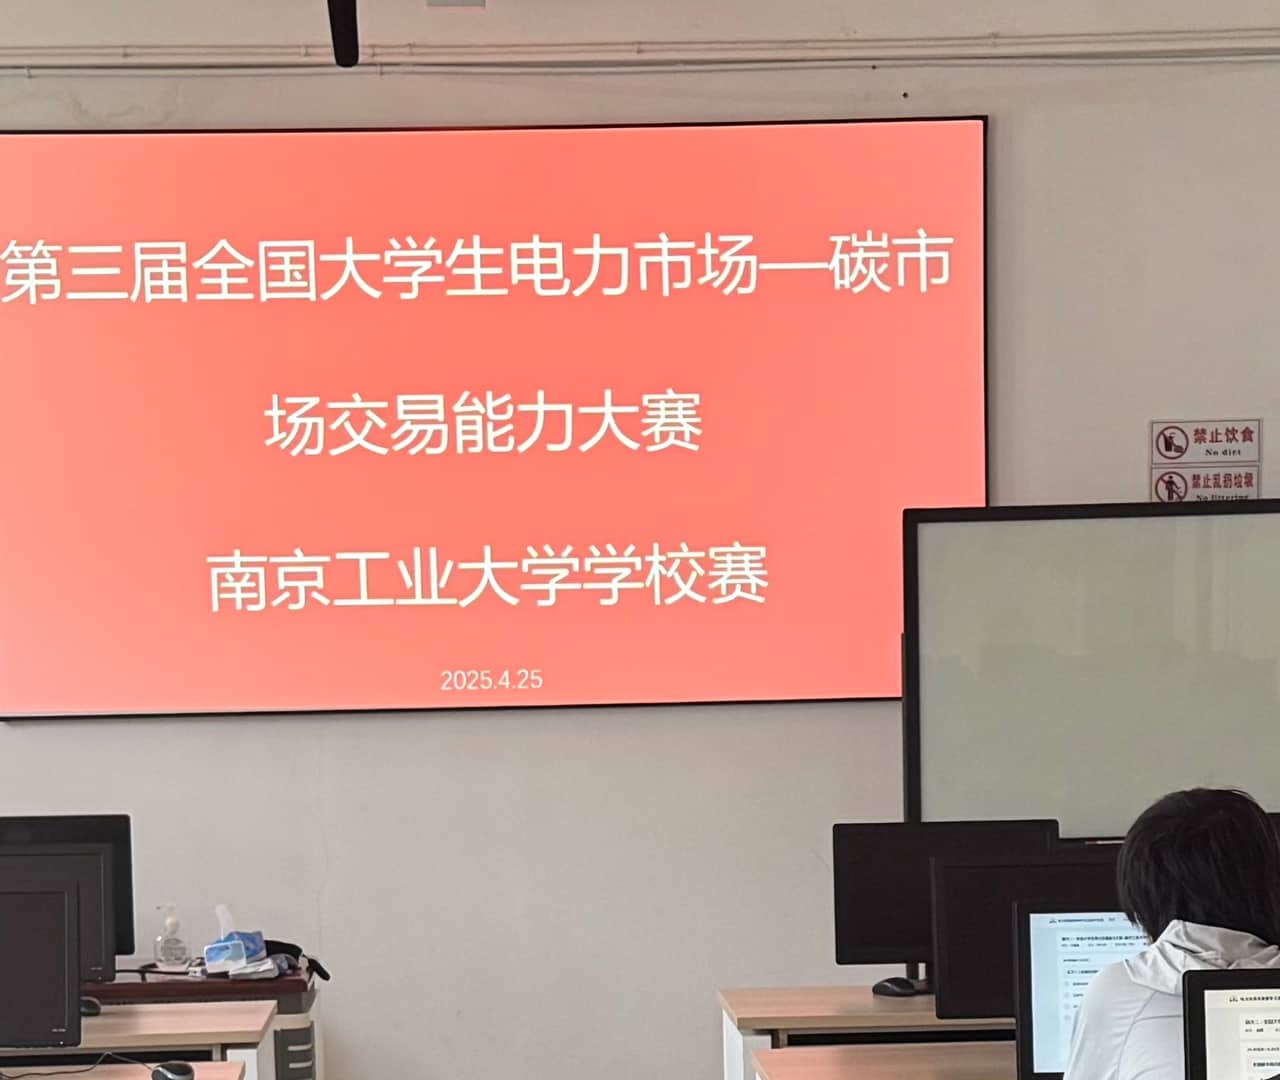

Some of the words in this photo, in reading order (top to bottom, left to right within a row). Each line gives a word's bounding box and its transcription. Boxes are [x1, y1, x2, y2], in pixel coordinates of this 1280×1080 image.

[264, 390, 702, 456] 场交易能力大赛
[1193, 426, 1254, 444] 禁止饮食
[206, 542, 769, 613] 南京工业大学学校赛
[440, 669, 544, 692] 2025.4.25
